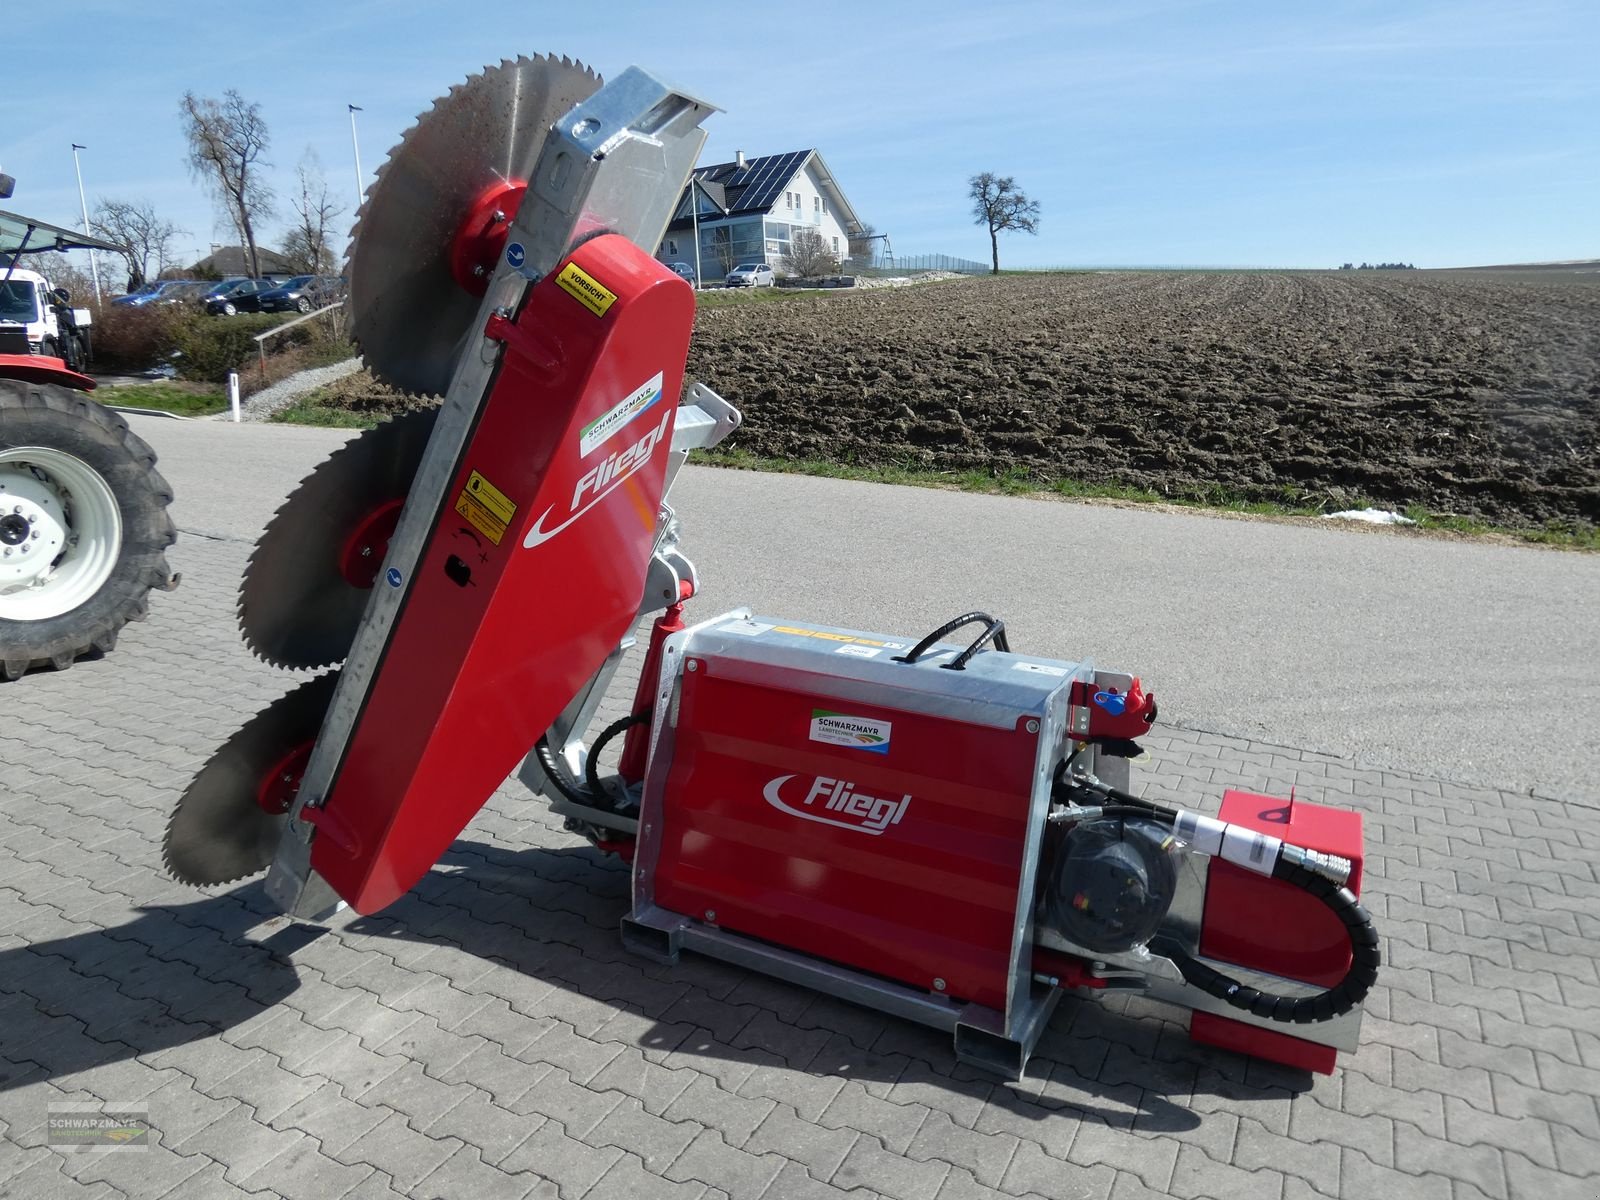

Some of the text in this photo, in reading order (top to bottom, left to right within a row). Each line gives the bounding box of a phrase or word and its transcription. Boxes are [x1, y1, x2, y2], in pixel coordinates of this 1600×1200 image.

[570, 272, 607, 301] VORSICHT
[587, 387, 652, 438] SCHWARZMAYR
[570, 408, 672, 512] Fliegl
[818, 718, 879, 735] SCHWARZMAYR
[818, 726, 854, 738] LANDTECHNIK
[803, 776, 913, 830] Fliegl
